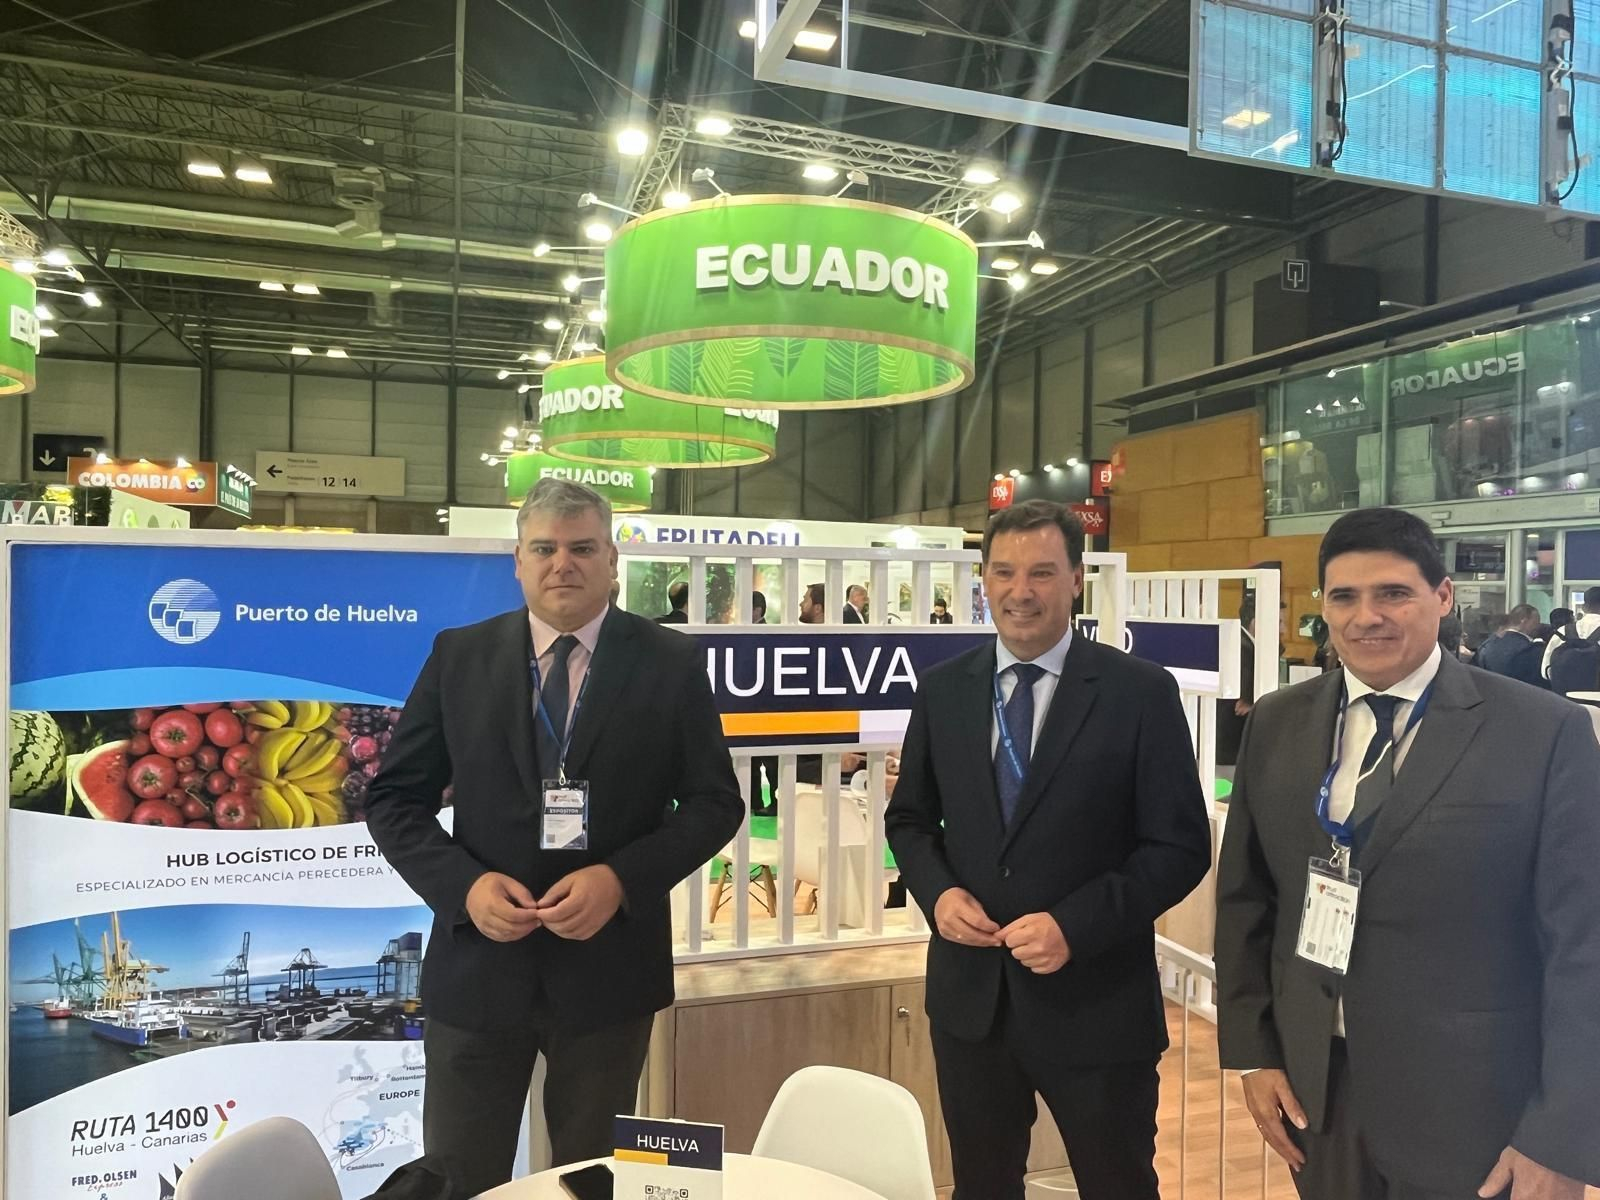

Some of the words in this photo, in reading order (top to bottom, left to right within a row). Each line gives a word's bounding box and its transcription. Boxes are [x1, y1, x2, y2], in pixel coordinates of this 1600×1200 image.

[695, 243, 949, 309] ECUADOR
[538, 384, 625, 422] UADOR
[78, 471, 183, 490] COLOMBIA
[323, 477, 335, 487] 12
[343, 477, 356, 487] 14
[540, 467, 634, 488] ECUADOR
[235, 604, 309, 622] Puerto
[314, 604, 341, 622] de
[347, 605, 418, 622] Huelva
[166, 853, 209, 868] HUB
[215, 847, 317, 866] LOGÍSTICO
[322, 846, 348, 860] DE
[76, 877, 187, 893] ESPECIALIZADO
[191, 876, 209, 886] EN
[214, 869, 294, 885] MERCANCÍA
[298, 866, 384, 880] PERECEDERA
[387, 866, 394, 874] Y
[379, 1089, 420, 1101] EUROPE
[70, 1114, 136, 1142] RUTA
[144, 1106, 209, 1134] 1400
[72, 1141, 125, 1157] Huelva
[141, 1131, 208, 1149] Canarias
[636, 1134, 700, 1153] HUELVA
